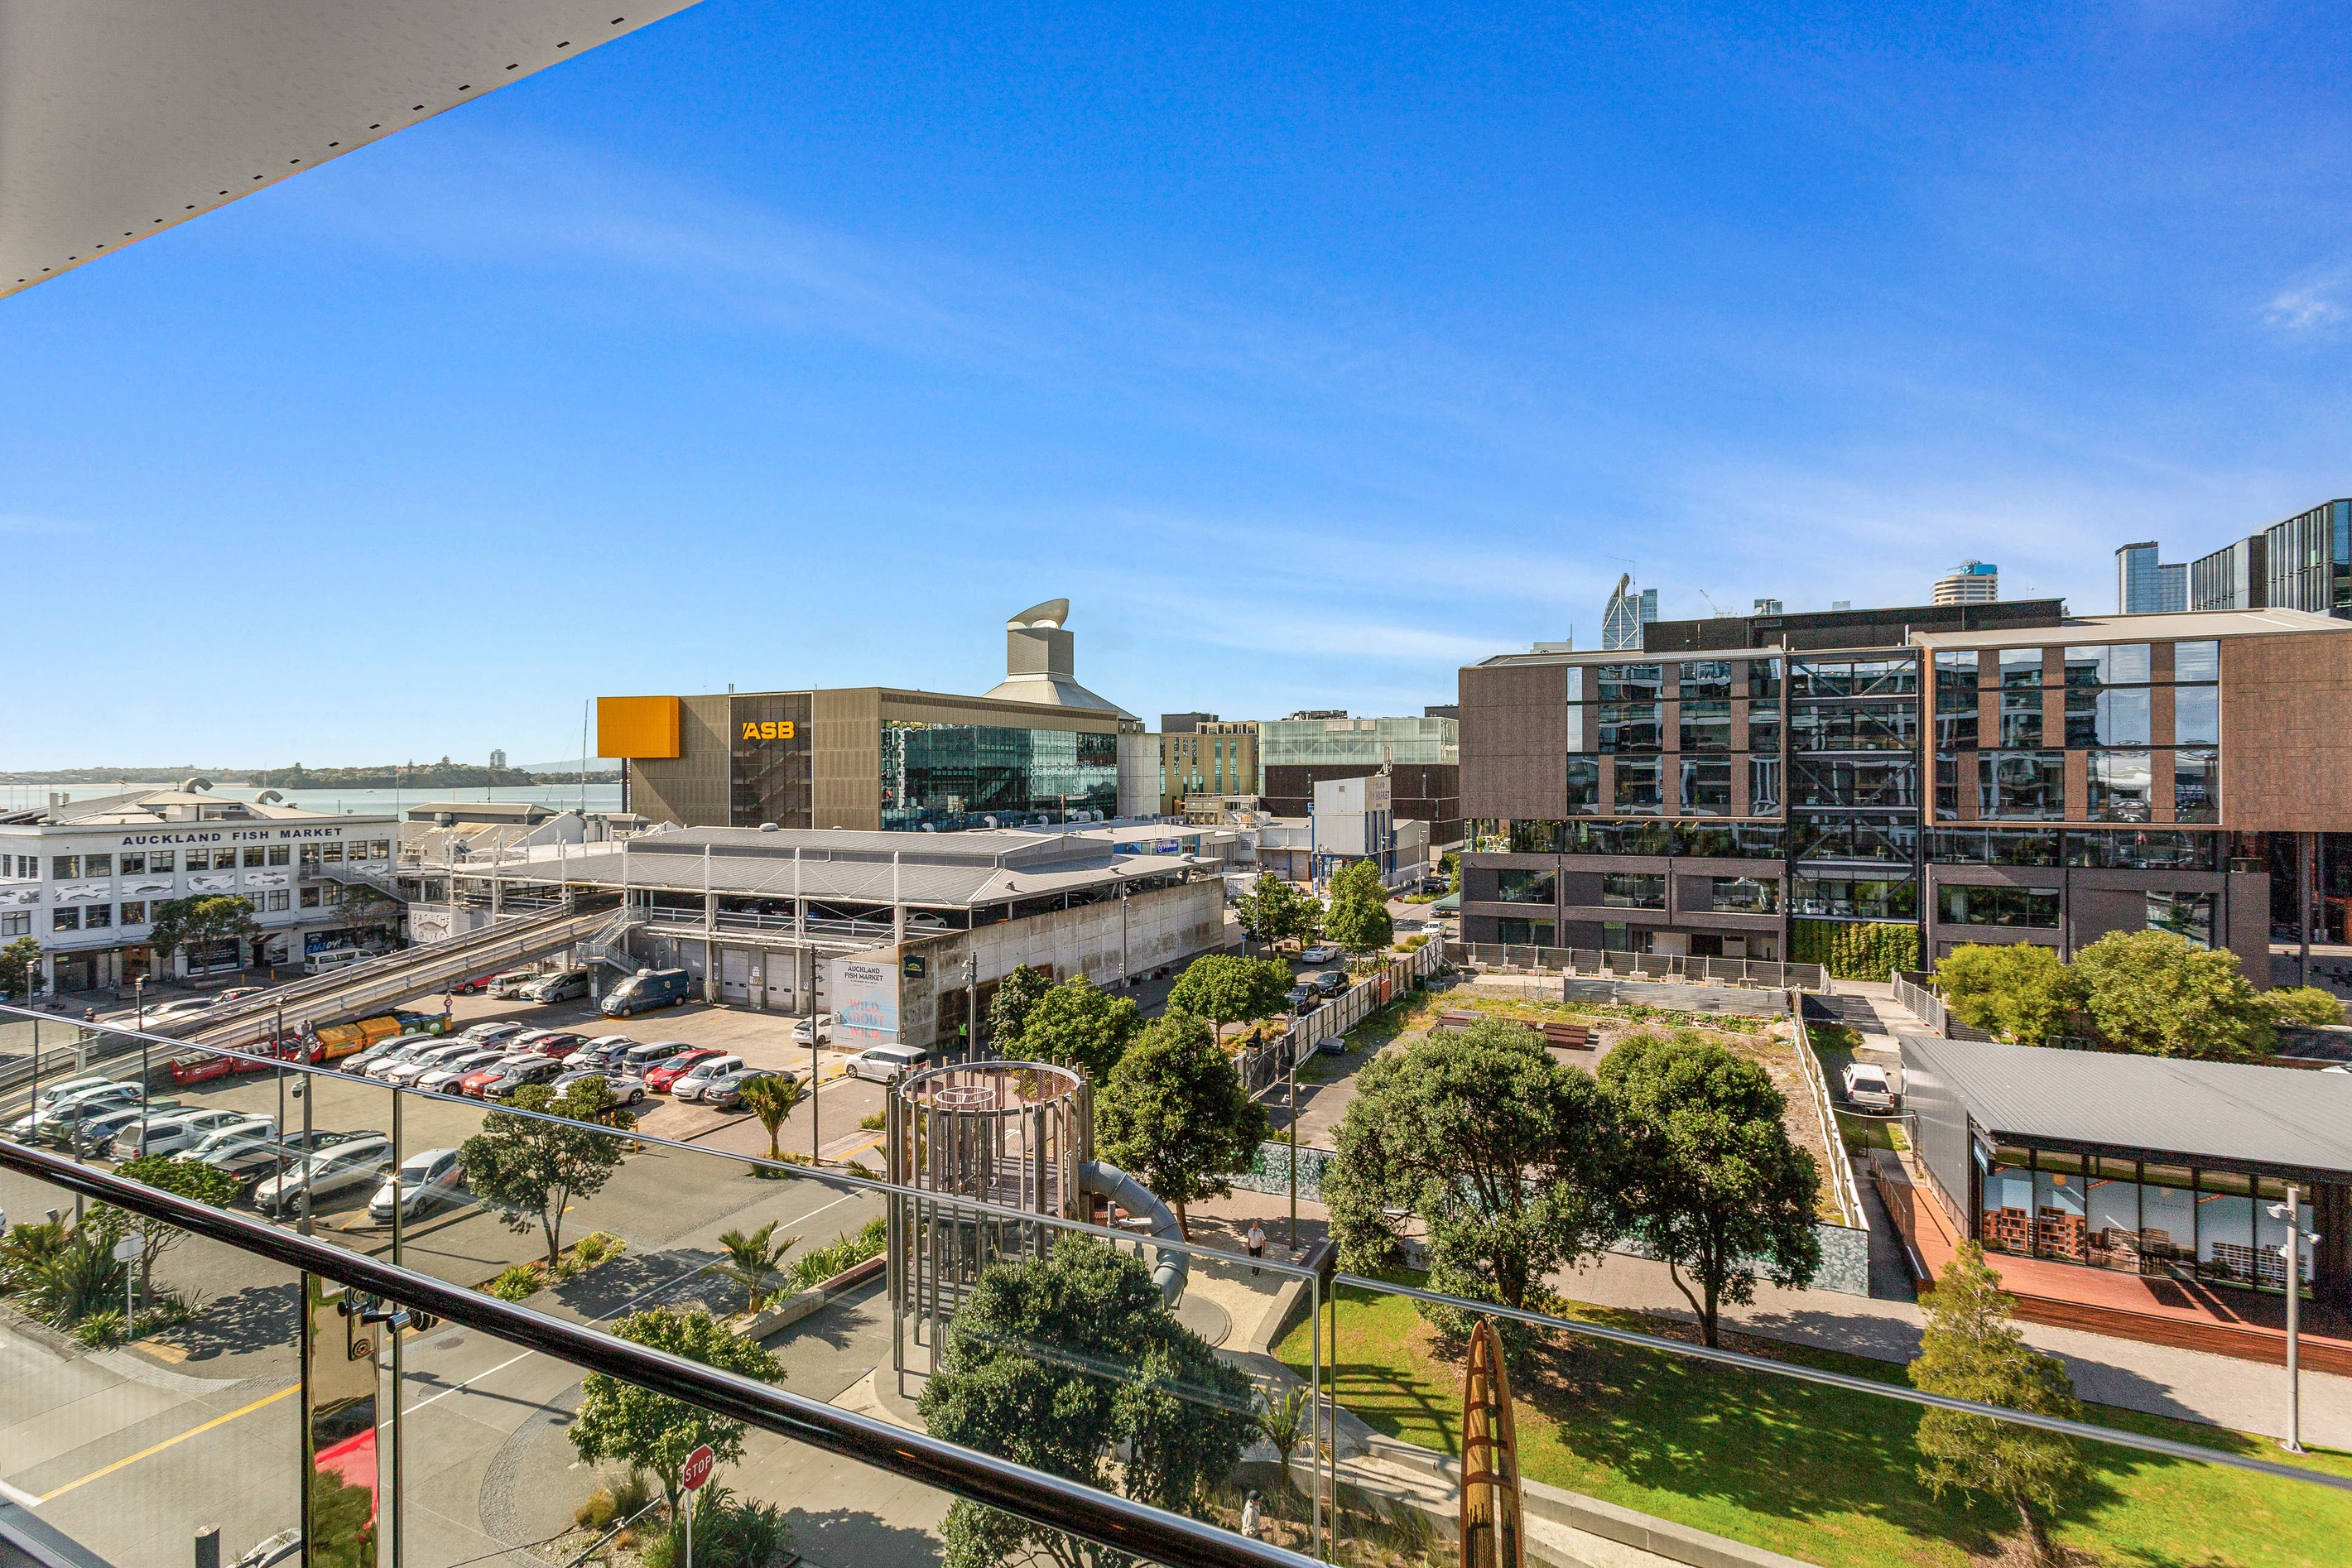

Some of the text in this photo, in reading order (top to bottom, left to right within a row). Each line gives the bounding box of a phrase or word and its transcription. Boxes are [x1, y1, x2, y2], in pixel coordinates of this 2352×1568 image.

[743, 721, 795, 739] ASB
[122, 828, 342, 845] AUCKLAND FISH MARKET
[413, 913, 428, 924] EAT
[435, 915, 450, 925] THE
[412, 928, 450, 941] SOURC
[848, 965, 880, 974] AUCKLAND
[859, 974, 883, 982] MARKET
[849, 998, 879, 1013] WILD
[845, 1012, 885, 1027] ABOUT
[849, 1026, 880, 1040] WILD
[685, 1455, 711, 1482] STOP
